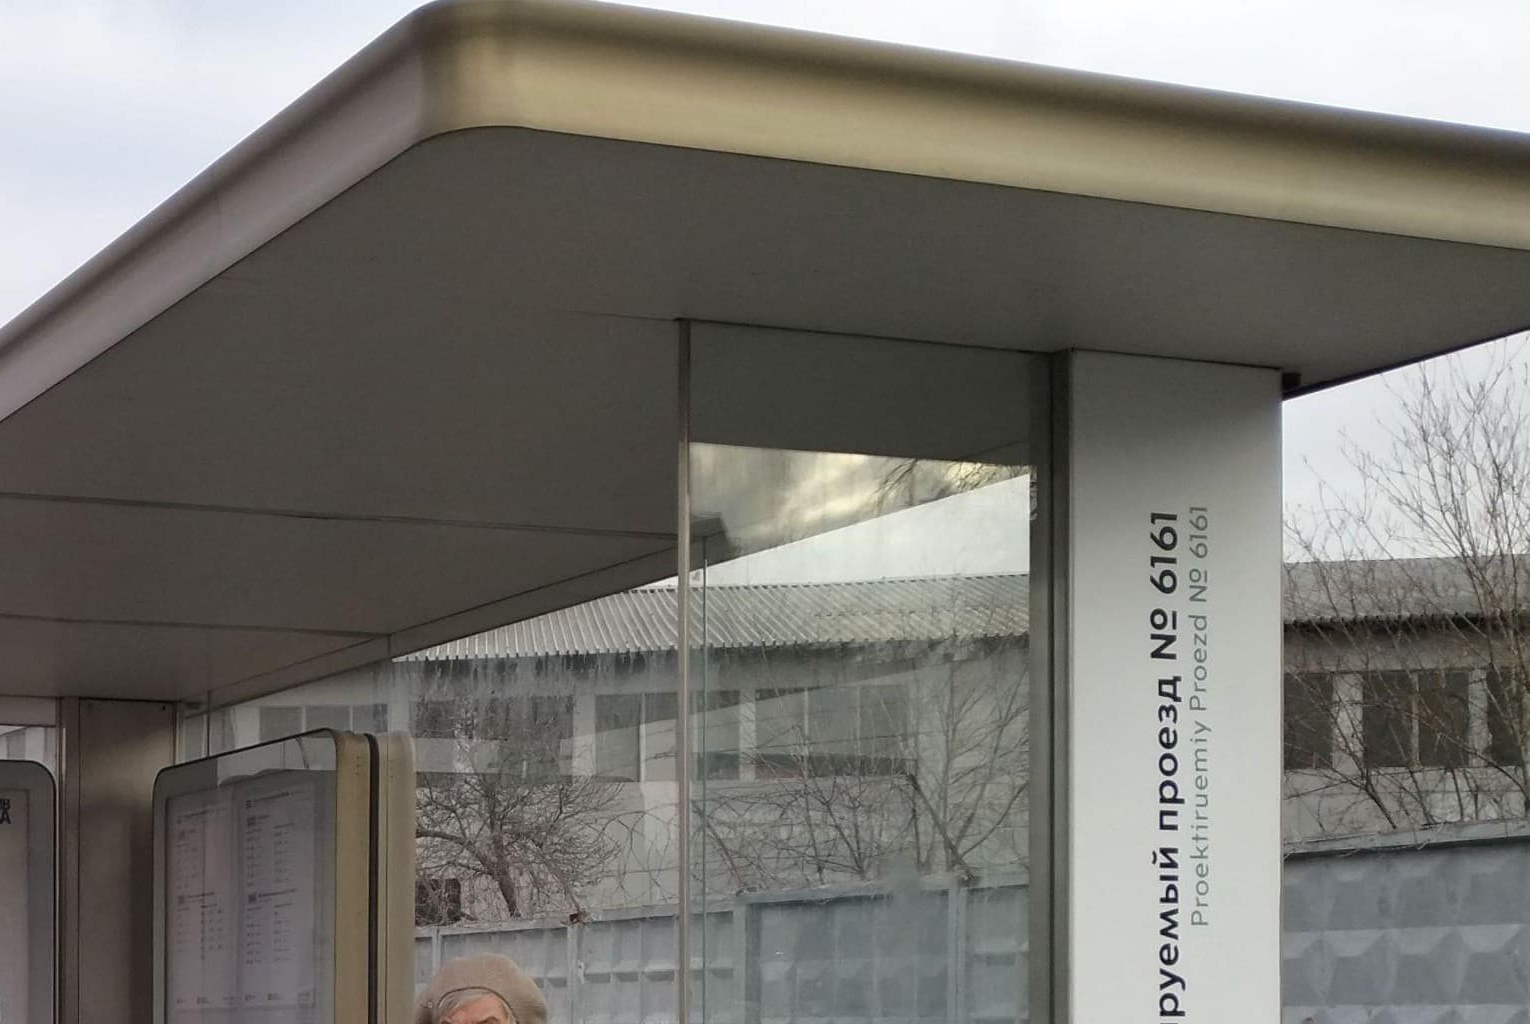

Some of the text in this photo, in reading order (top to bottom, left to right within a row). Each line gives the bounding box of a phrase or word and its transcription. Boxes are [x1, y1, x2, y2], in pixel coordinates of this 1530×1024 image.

[1150, 512, 1178, 594] 6161
[1150, 608, 1177, 660] №
[1156, 675, 1183, 831] проезд
[1188, 506, 1212, 927] Proektiruemiy Proezd № 6161
